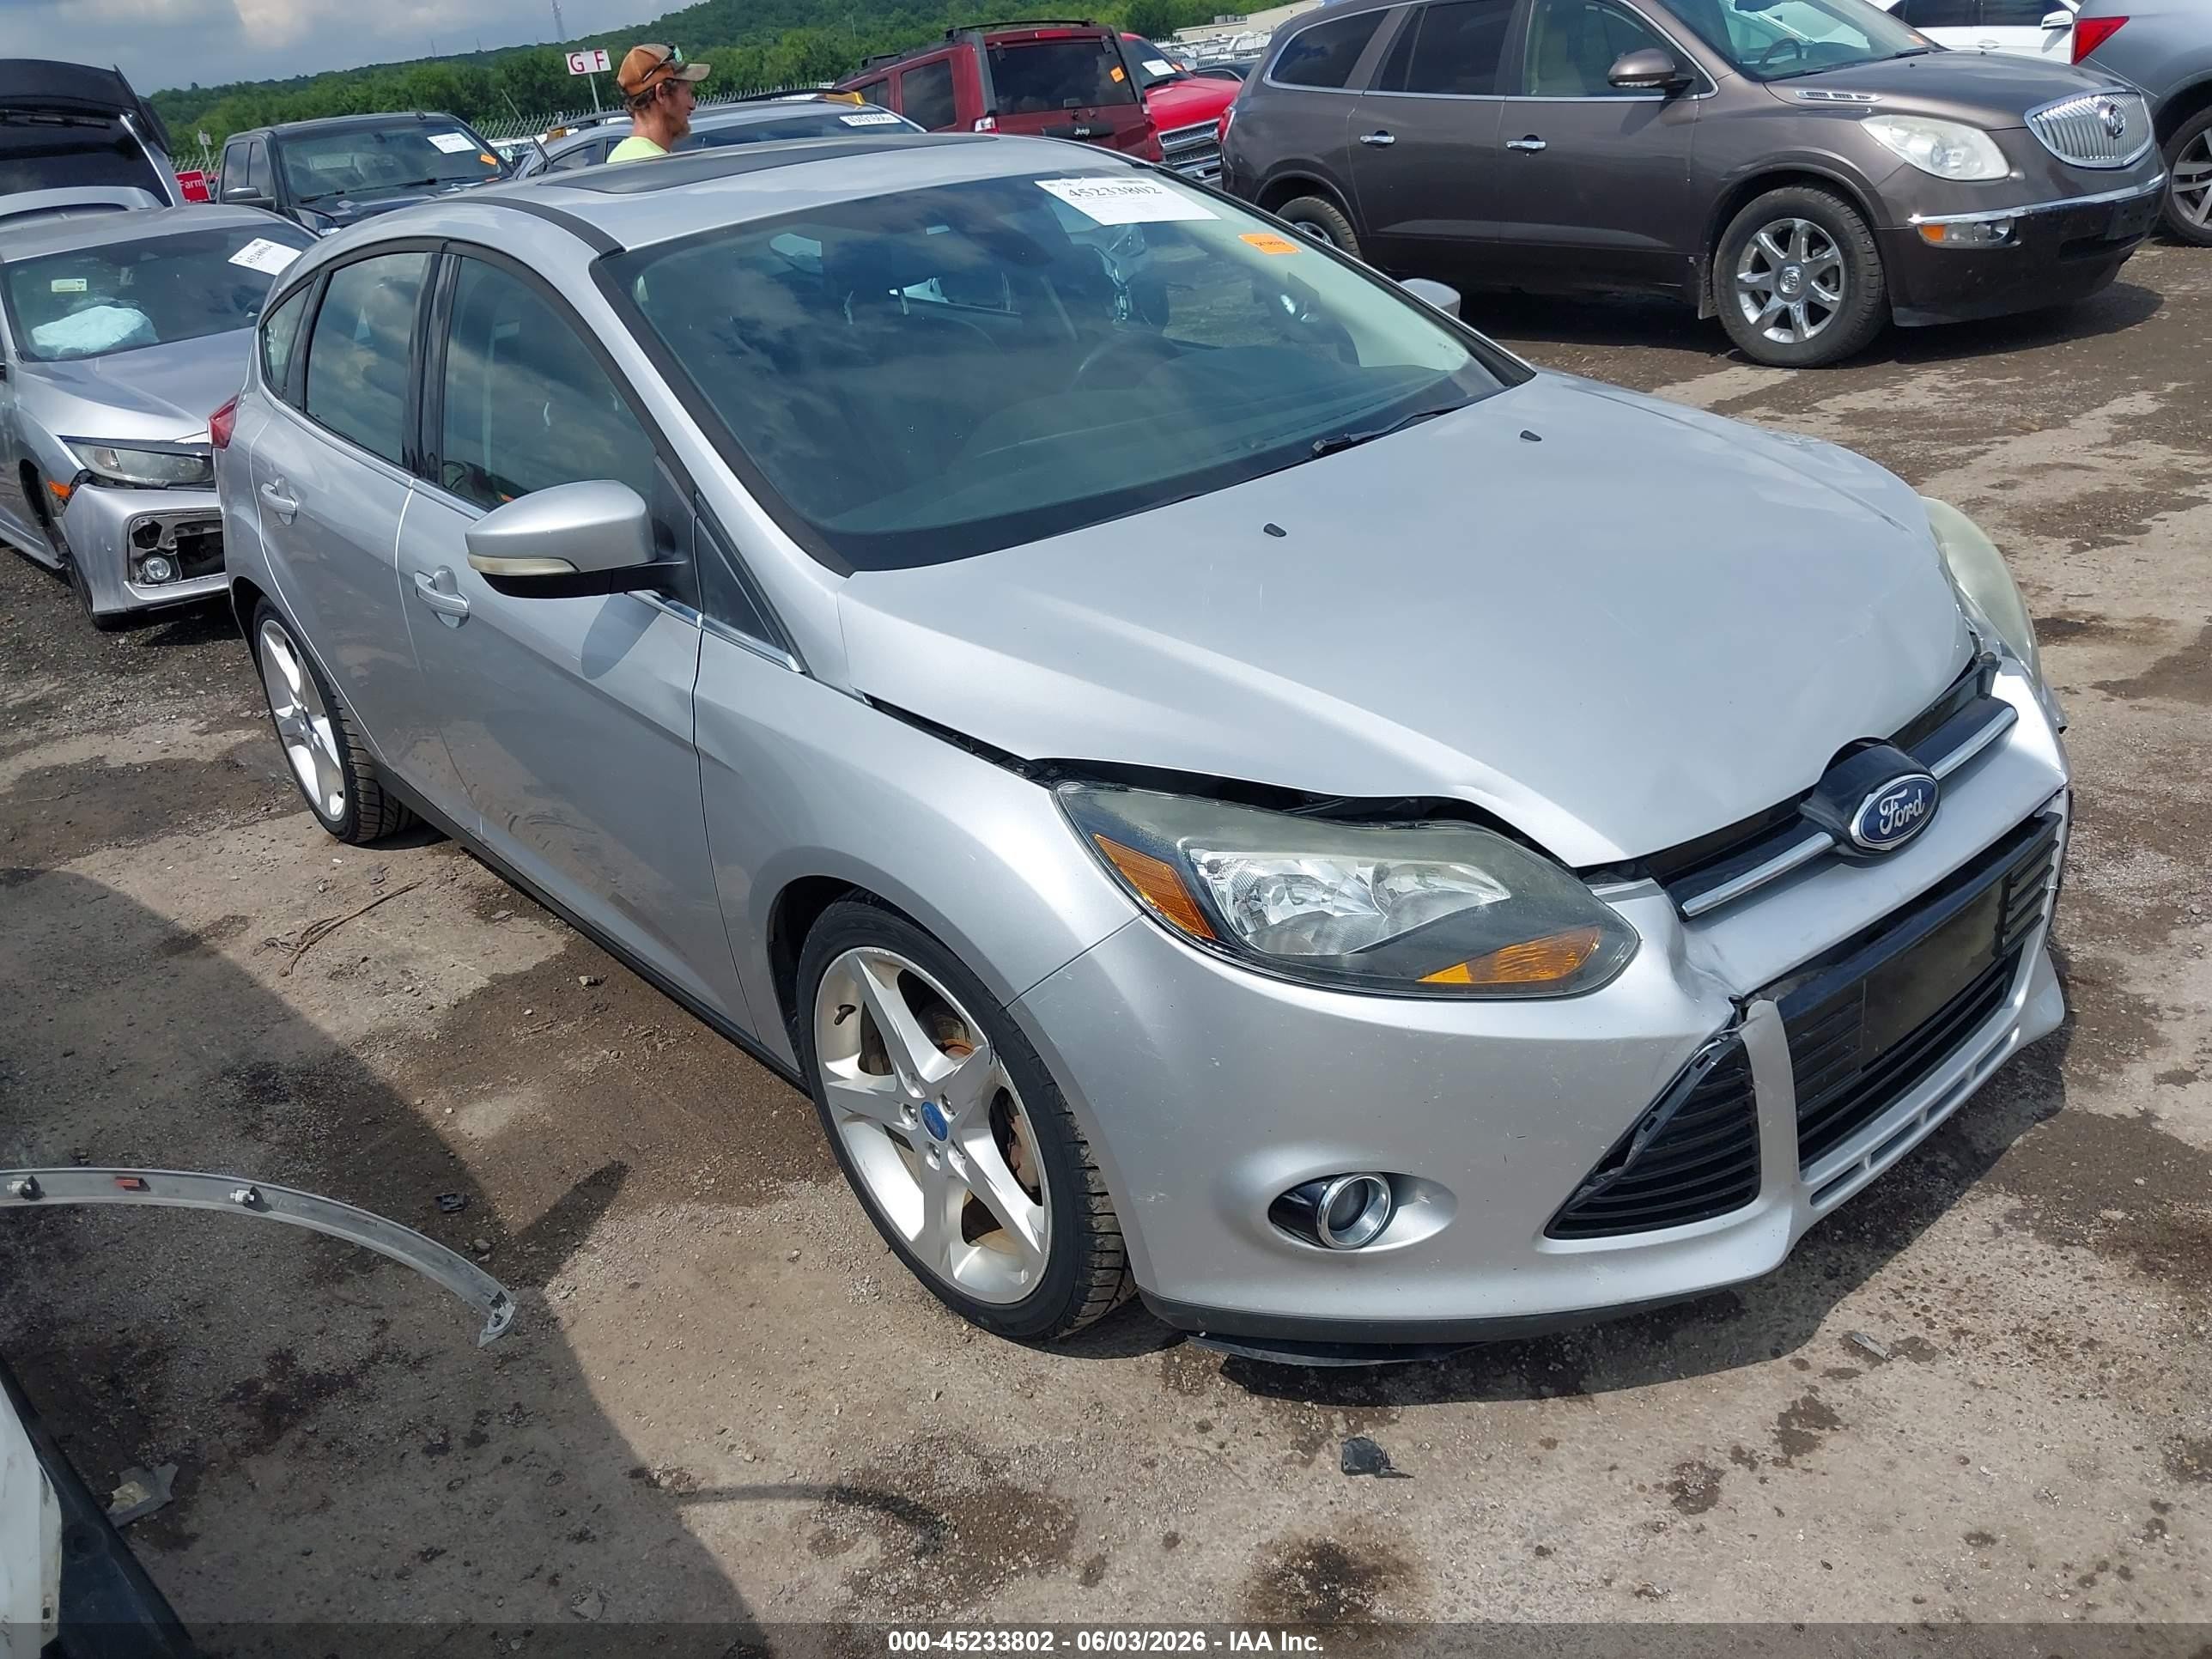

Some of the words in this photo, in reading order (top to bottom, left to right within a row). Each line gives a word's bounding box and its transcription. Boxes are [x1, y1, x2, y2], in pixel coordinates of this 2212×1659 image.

[569, 53, 585, 73] G
[594, 51, 605, 70] F
[1068, 185, 1162, 198] 45233802
[1879, 787, 1925, 836] Ford
